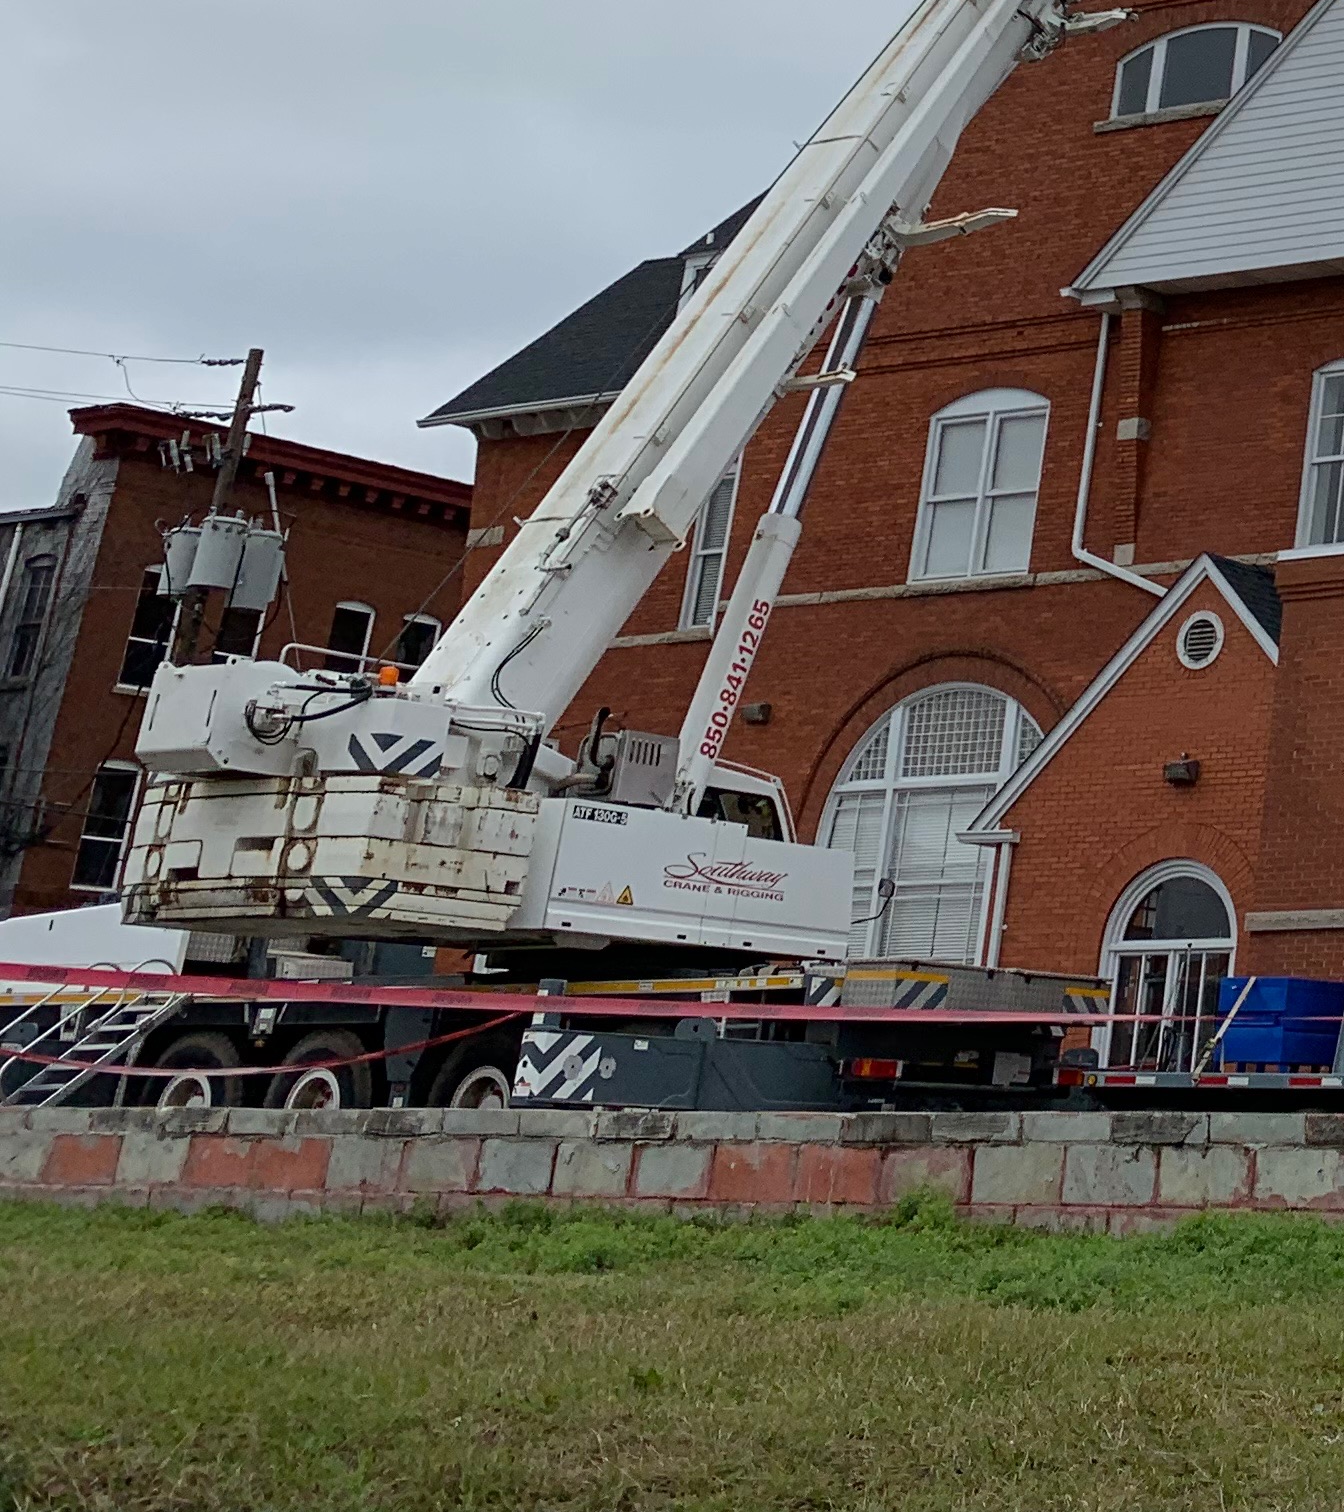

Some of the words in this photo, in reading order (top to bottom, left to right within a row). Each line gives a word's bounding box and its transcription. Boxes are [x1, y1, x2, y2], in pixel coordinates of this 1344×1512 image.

[573, 806, 593, 820] ATF
[664, 852, 788, 889] Southway
[663, 879, 710, 893] CRANE
[713, 886, 723, 894] &
[727, 888, 784, 902] RIGGING
